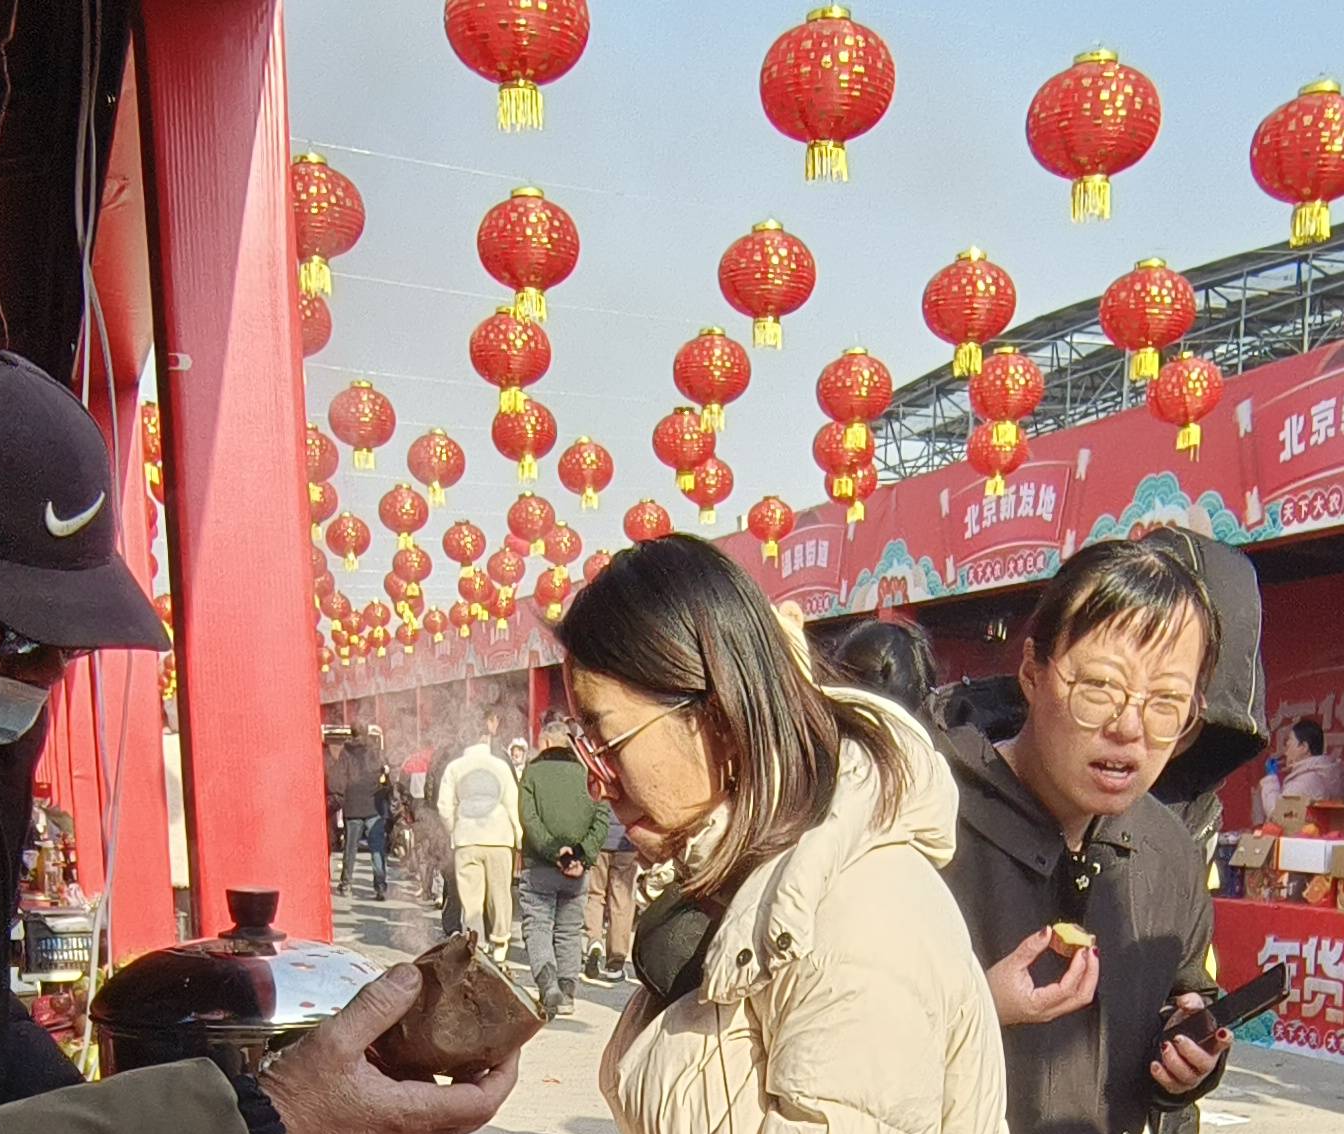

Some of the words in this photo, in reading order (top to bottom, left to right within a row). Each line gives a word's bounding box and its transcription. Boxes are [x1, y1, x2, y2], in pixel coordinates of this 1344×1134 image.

[963, 481, 1057, 540] 北京新发地
[1282, 490, 1342, 523] 天下大农
